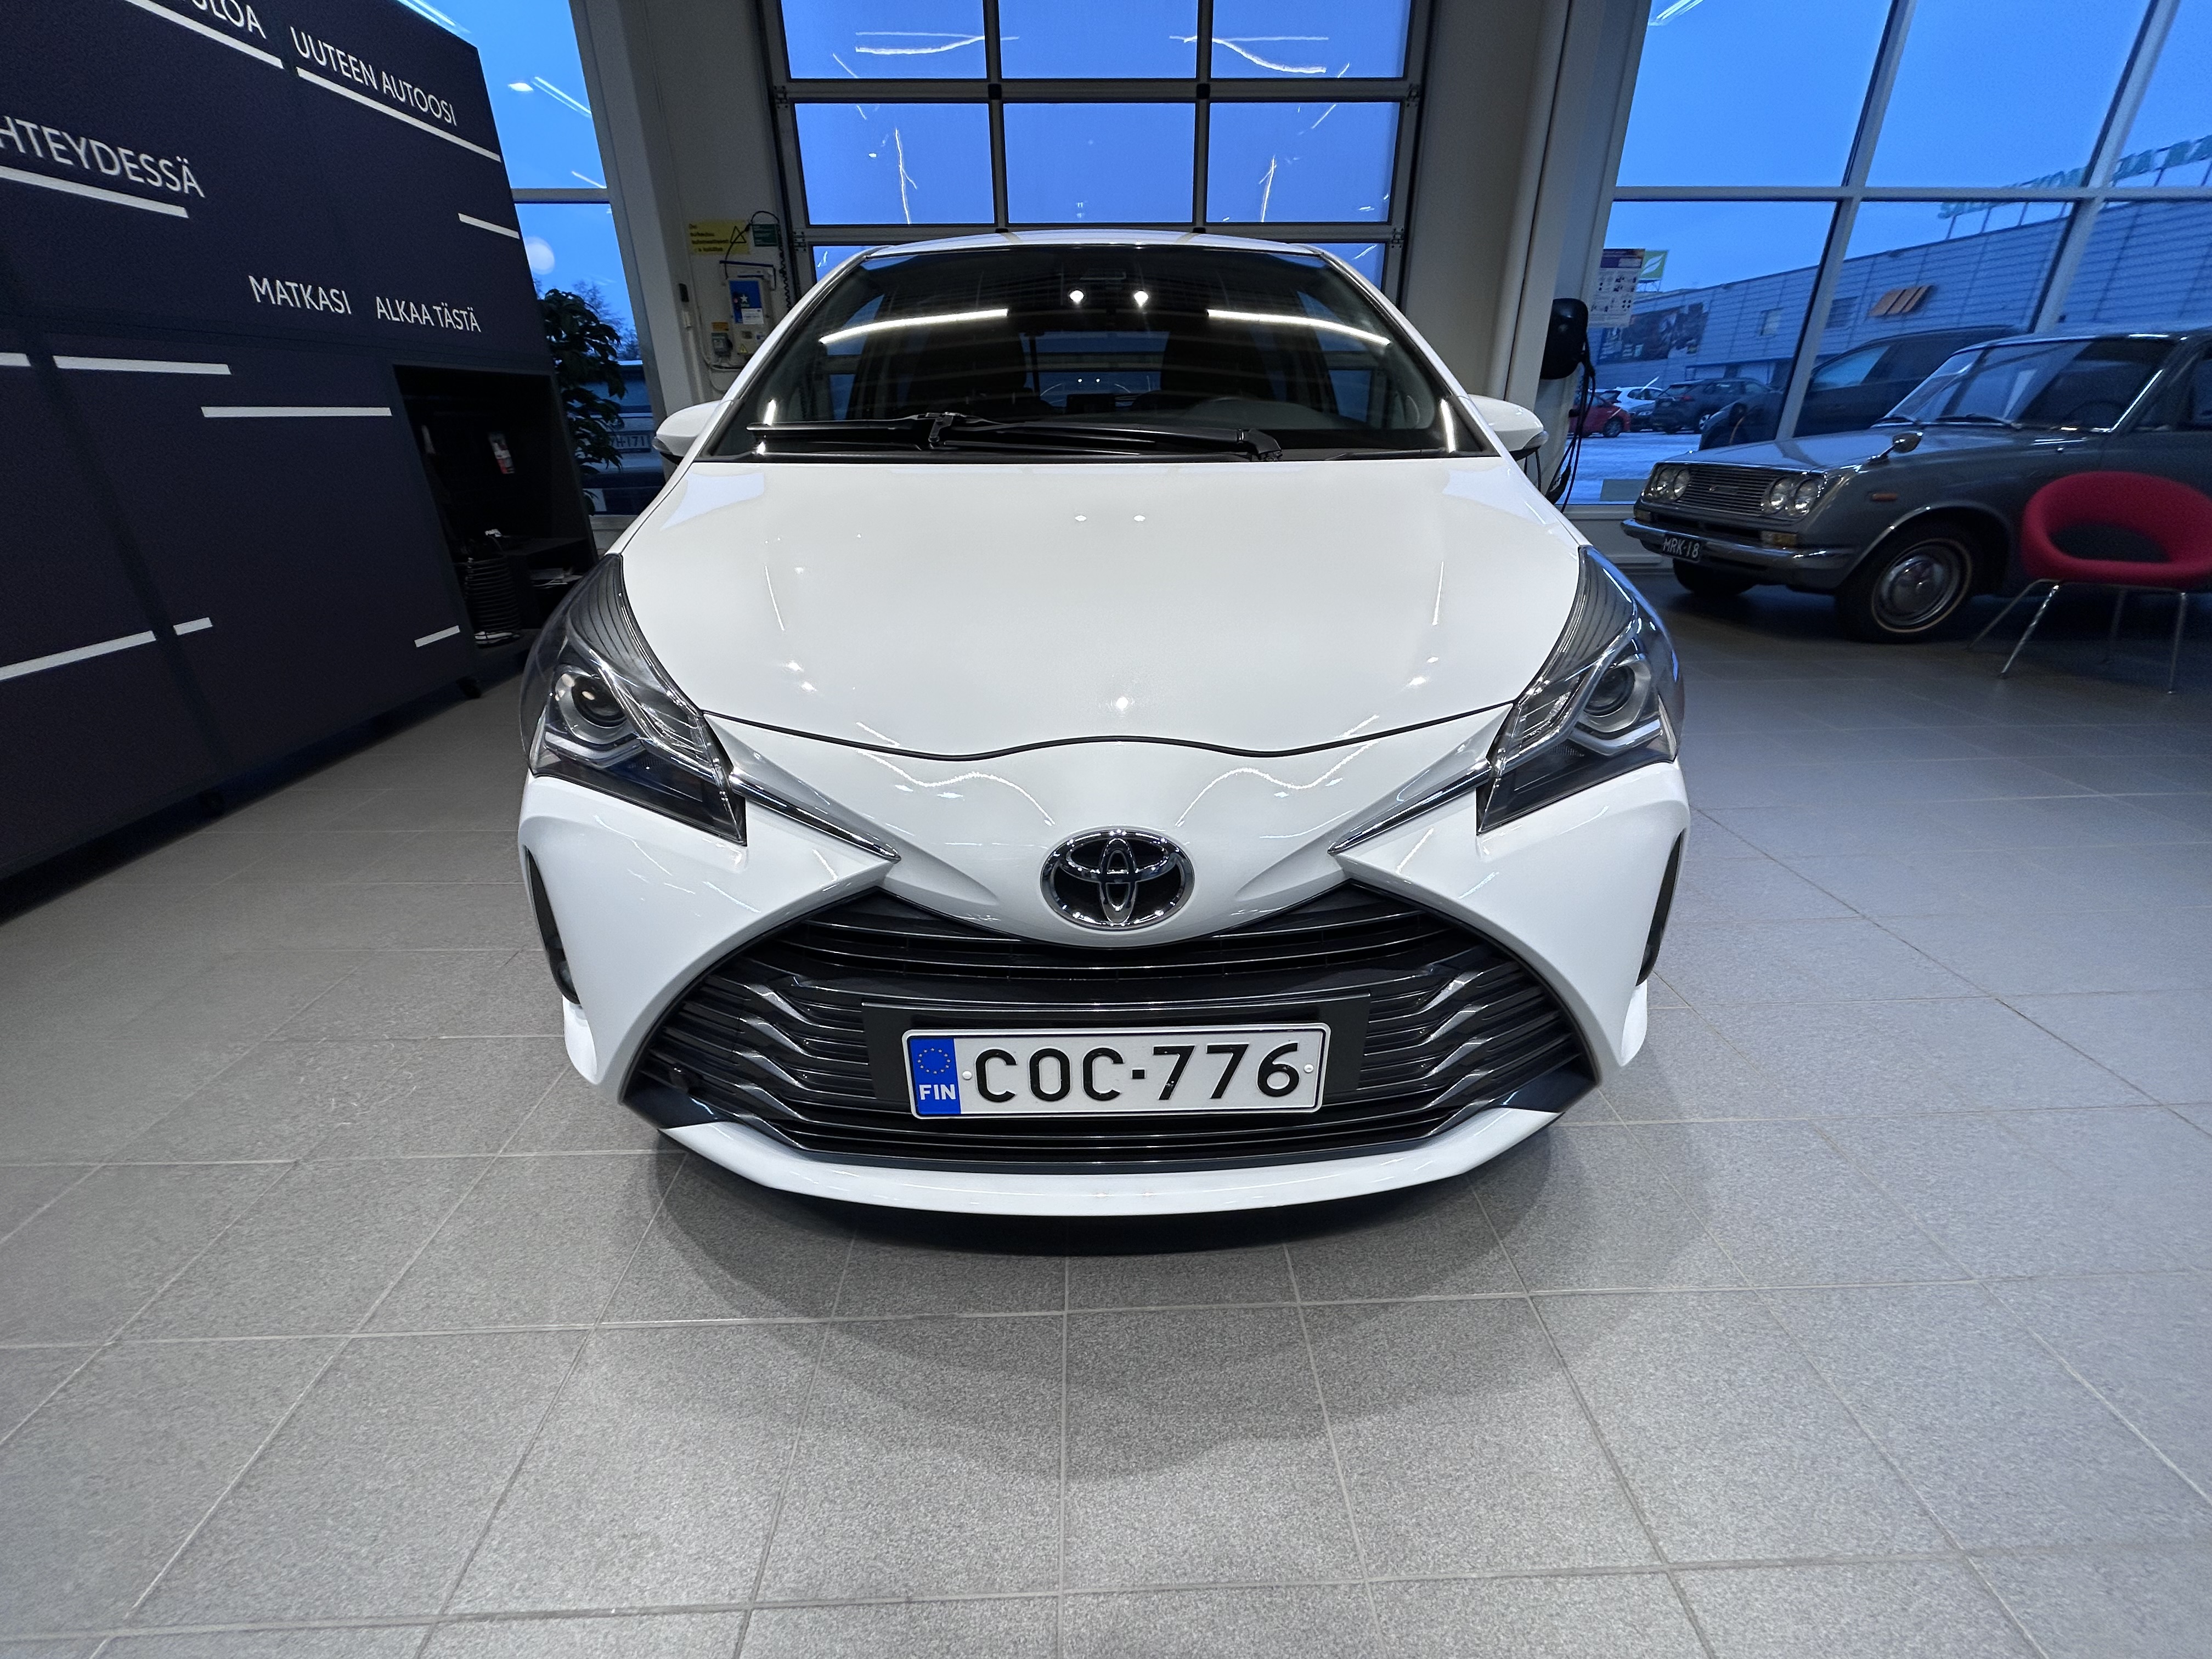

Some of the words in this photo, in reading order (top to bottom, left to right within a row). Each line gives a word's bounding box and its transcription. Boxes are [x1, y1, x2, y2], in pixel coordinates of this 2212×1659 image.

[290, 26, 378, 91] UUTEEN
[383, 71, 457, 126] AUTOOSI
[249, 275, 352, 314] MATKASI
[376, 296, 435, 326] ALKAA
[432, 302, 482, 332] TÄSTÄ
[1663, 538, 1700, 558] MRK-18
[918, 1084, 957, 1101] FIN
